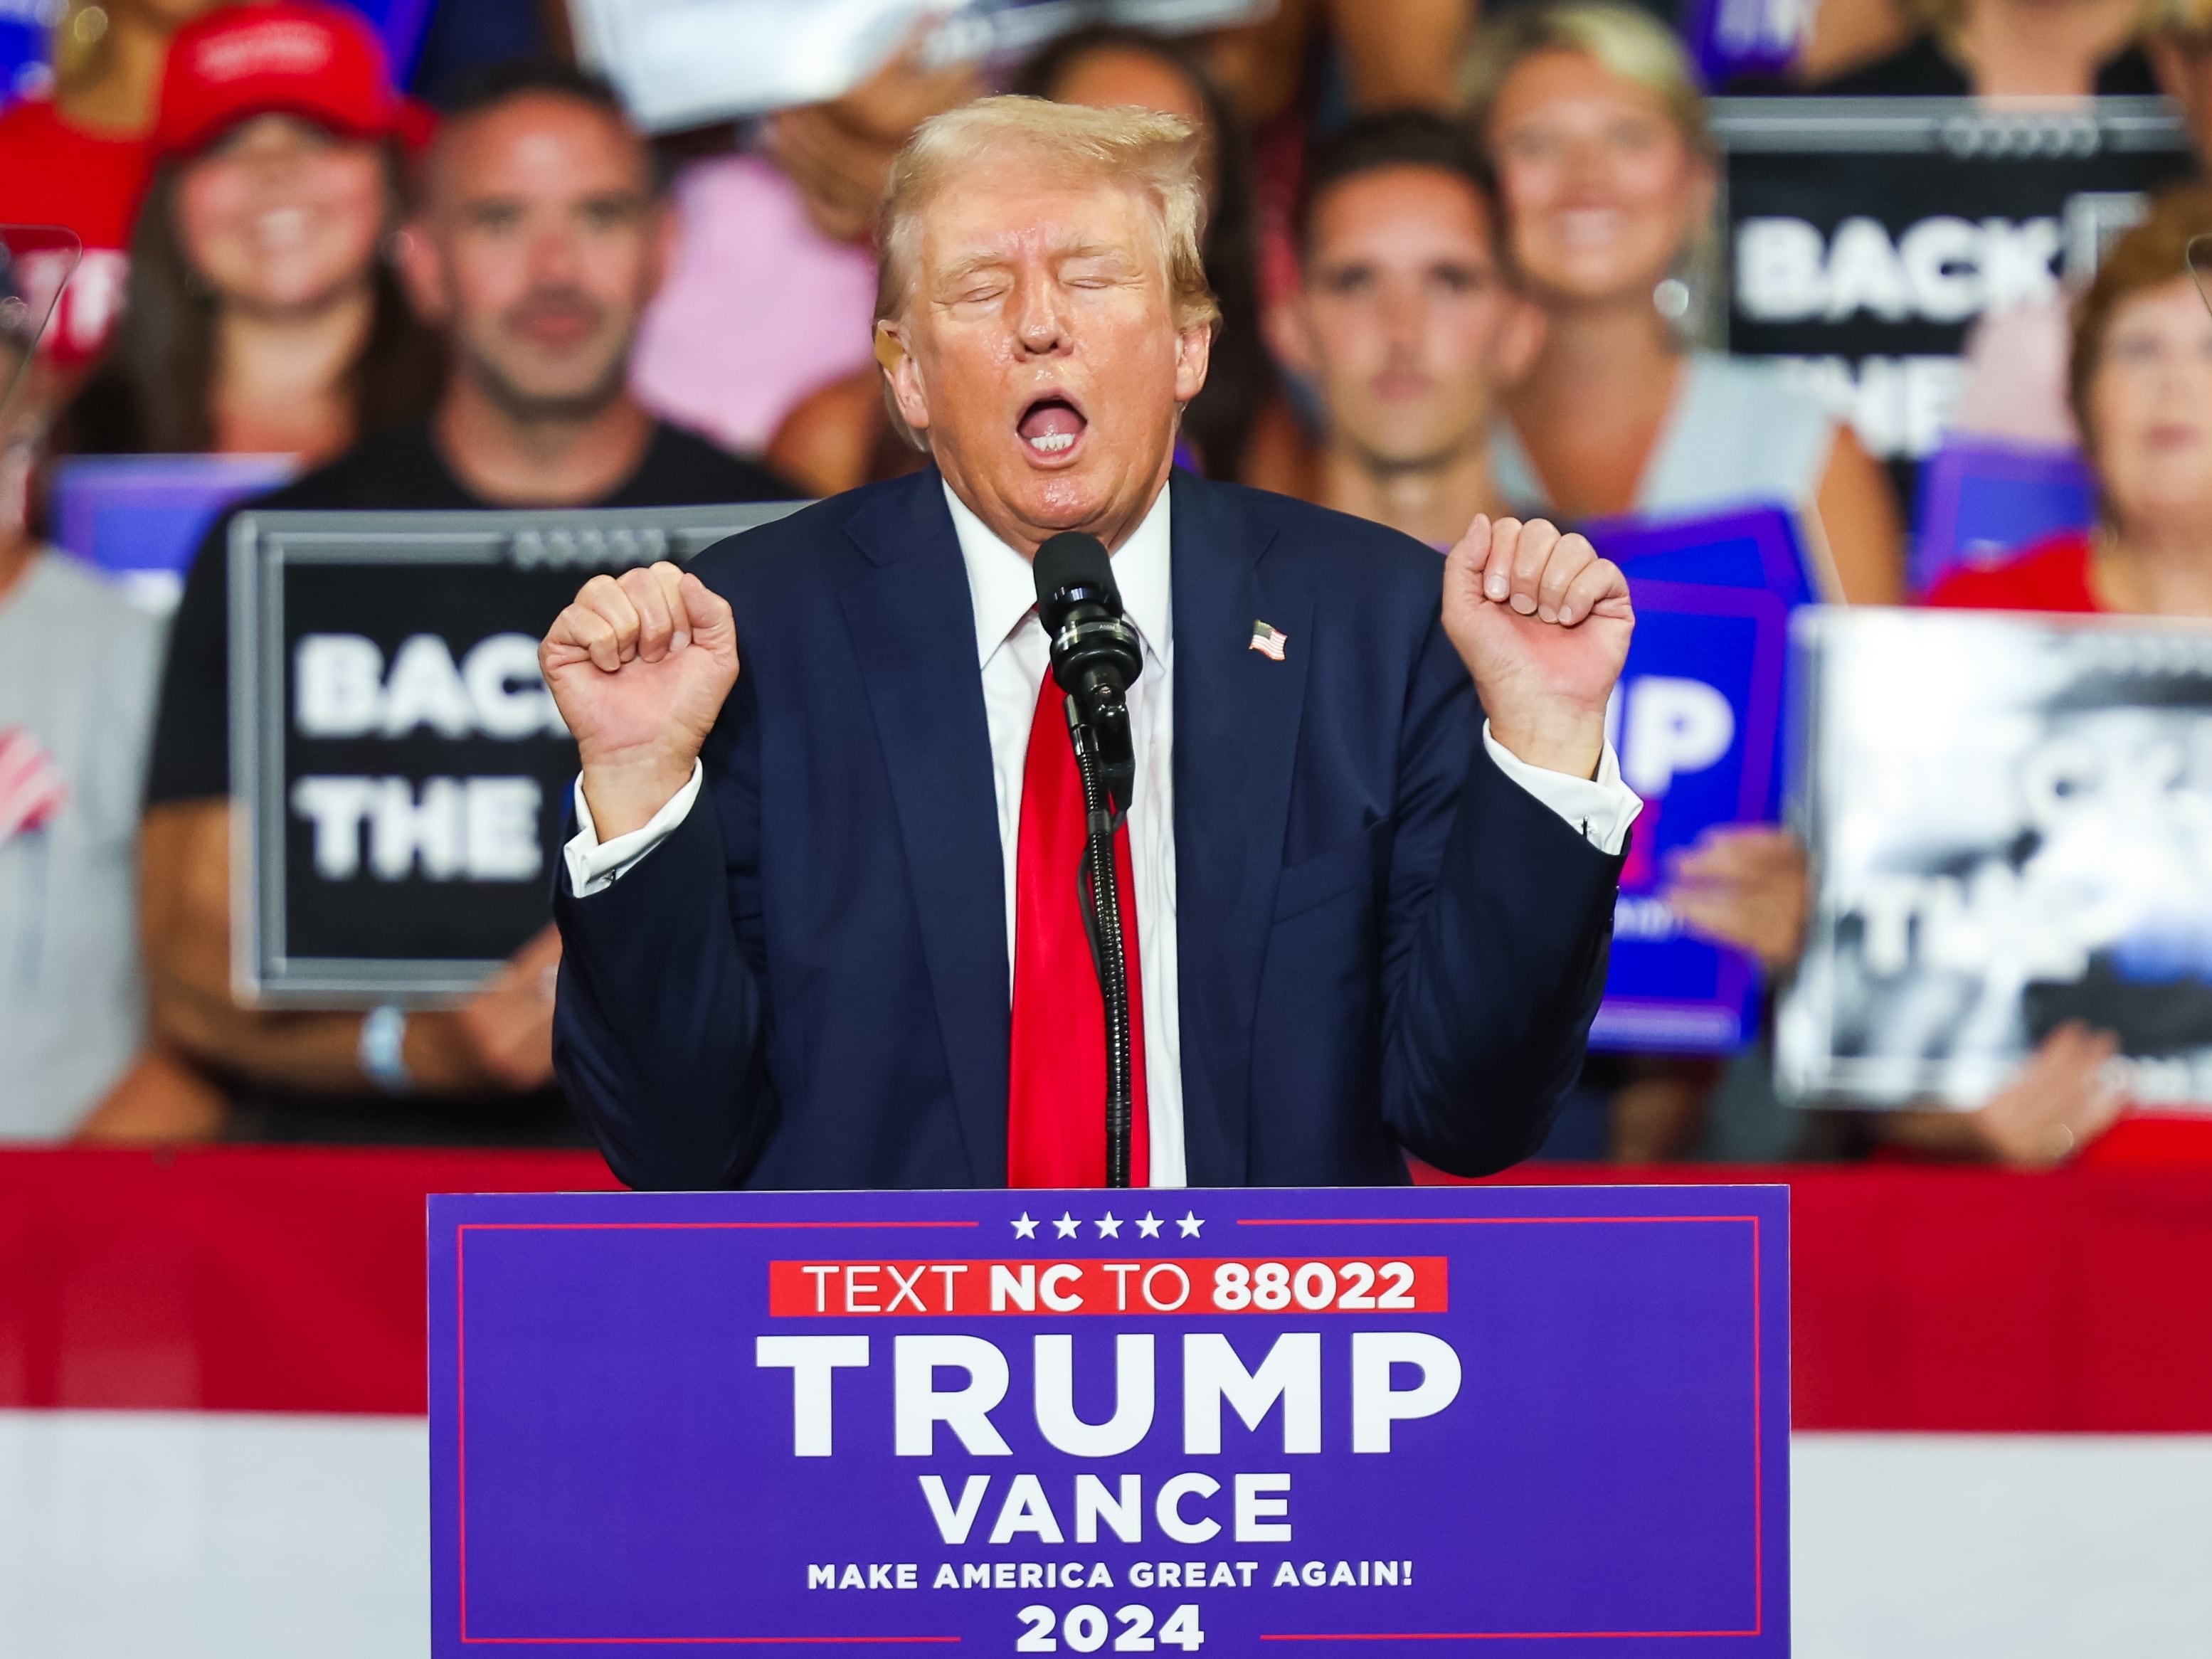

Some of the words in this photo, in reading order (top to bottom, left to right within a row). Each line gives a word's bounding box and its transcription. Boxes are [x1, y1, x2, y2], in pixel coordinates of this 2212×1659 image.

[1734, 216, 2067, 322] BACK
[294, 632, 575, 741] BAC
[290, 775, 544, 882] THE
[802, 1265, 968, 1313] TEXT
[990, 1263, 1084, 1312] NC
[1102, 1263, 1190, 1311] TO
[1212, 1261, 1416, 1311] 88022
[756, 1332, 1463, 1458] TRUMP
[919, 1472, 1292, 1545] VANCE
[808, 1564, 919, 1589] MAKE
[933, 1562, 1115, 1589] AMERICA
[1128, 1562, 1259, 1588] GREAT
[1272, 1561, 1413, 1587] AGAIN!
[1016, 1604, 1205, 1653] 2024
